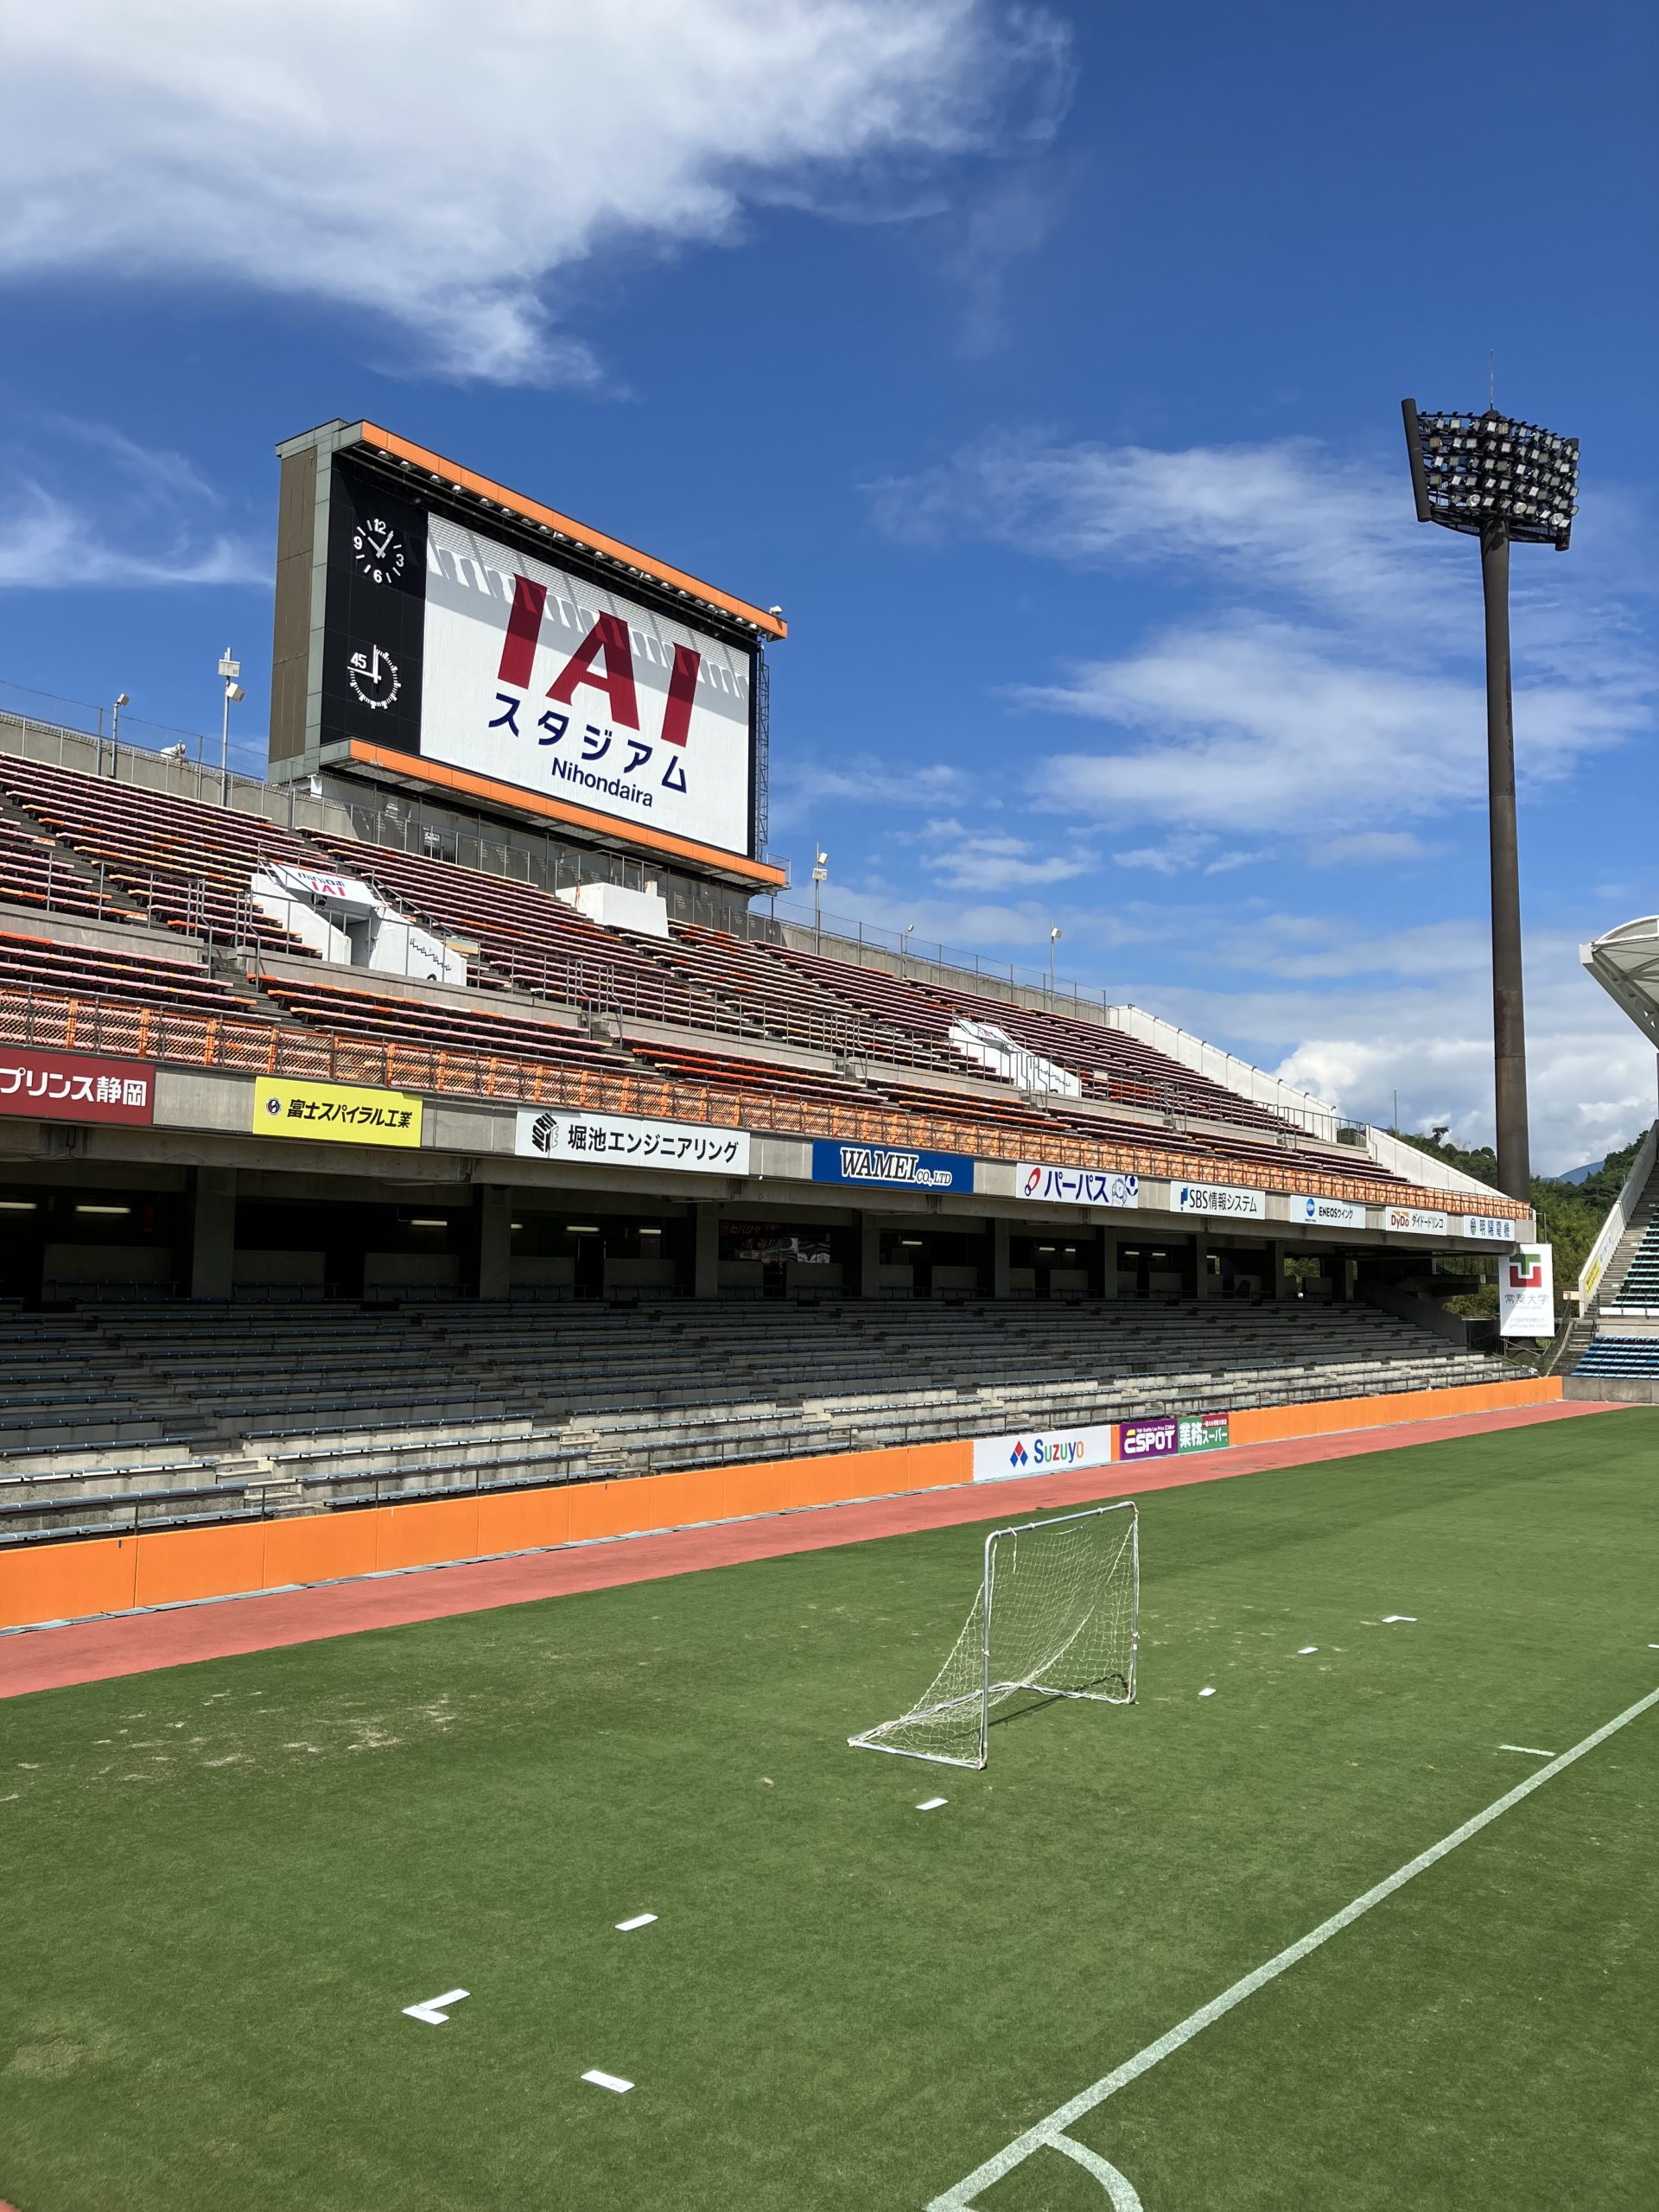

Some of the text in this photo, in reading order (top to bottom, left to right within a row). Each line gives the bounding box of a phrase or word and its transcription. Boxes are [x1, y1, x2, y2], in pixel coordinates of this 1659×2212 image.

[373, 518, 386, 535] 12
[353, 536, 363, 550] 9
[396, 553, 404, 568] 3
[372, 569, 383, 583] 6
[350, 652, 367, 670] 45
[498, 573, 701, 747] IAI
[488, 692, 688, 794] スタジアム
[551, 756, 653, 808] Nihondaira
[311, 880, 346, 897] IAI
[0, 1067, 147, 1107] プリンス静岡
[287, 1098, 413, 1128] 富士スパイラル工業
[568, 1124, 739, 1165] 堀池エンジニアリング
[841, 1147, 919, 1182] WAMEI
[1044, 1170, 1109, 1204] パーパス
[1391, 1214, 1409, 1230] DyDo
[1411, 1214, 1444, 1230] ダイドードリンコ
[1179, 1421, 1228, 1448] 業務スーパー
[1034, 1438, 1084, 1464] Suzuyo
